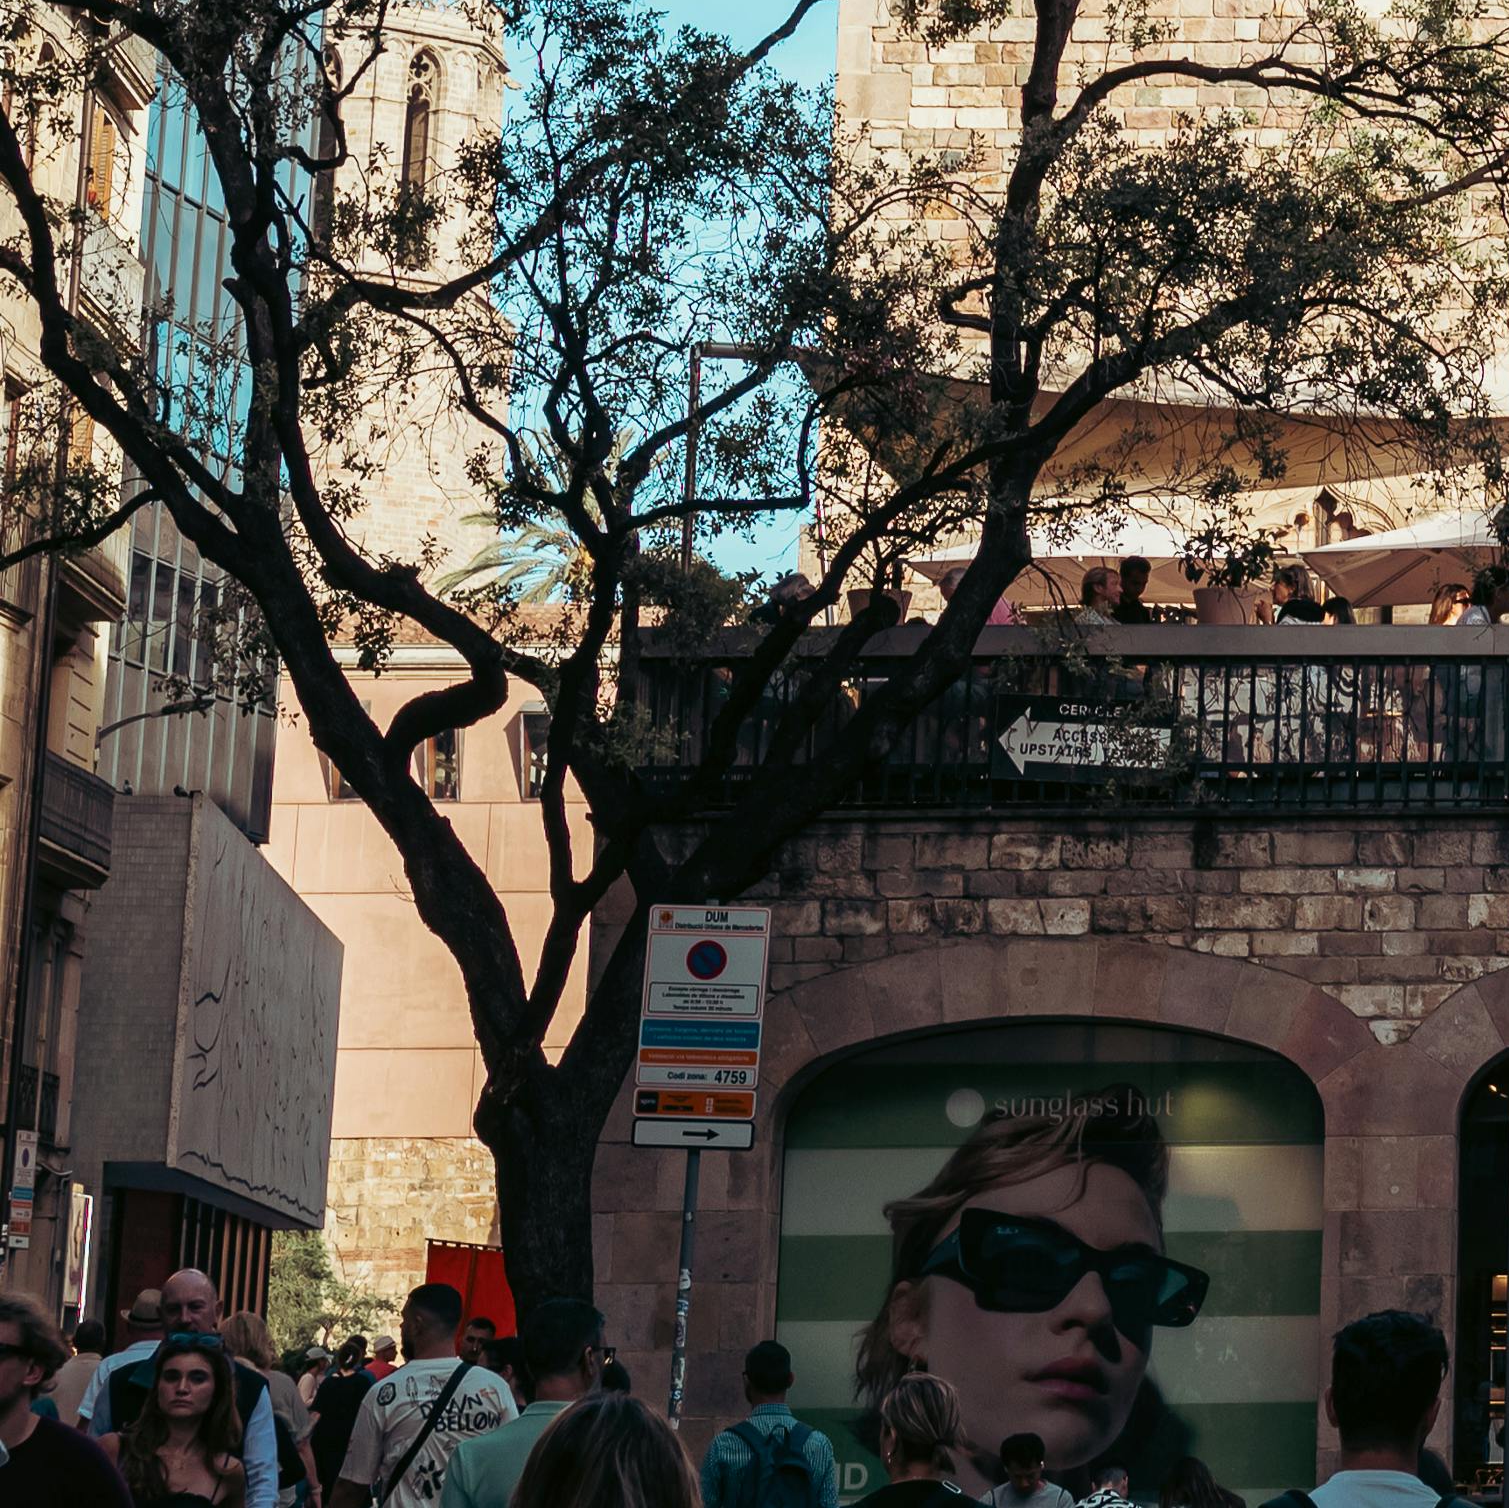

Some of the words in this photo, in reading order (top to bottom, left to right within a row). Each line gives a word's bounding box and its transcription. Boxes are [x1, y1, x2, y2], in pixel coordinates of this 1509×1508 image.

[1019, 743, 1092, 759] UPSTAIRS
[705, 910, 729, 923] DUM
[667, 1071, 687, 1080] Codi
[714, 1070, 747, 1084] 4759
[994, 1089, 1119, 1125] sunglass
[1127, 1089, 1174, 1117] hut
[420, 1393, 484, 1420] DWN
